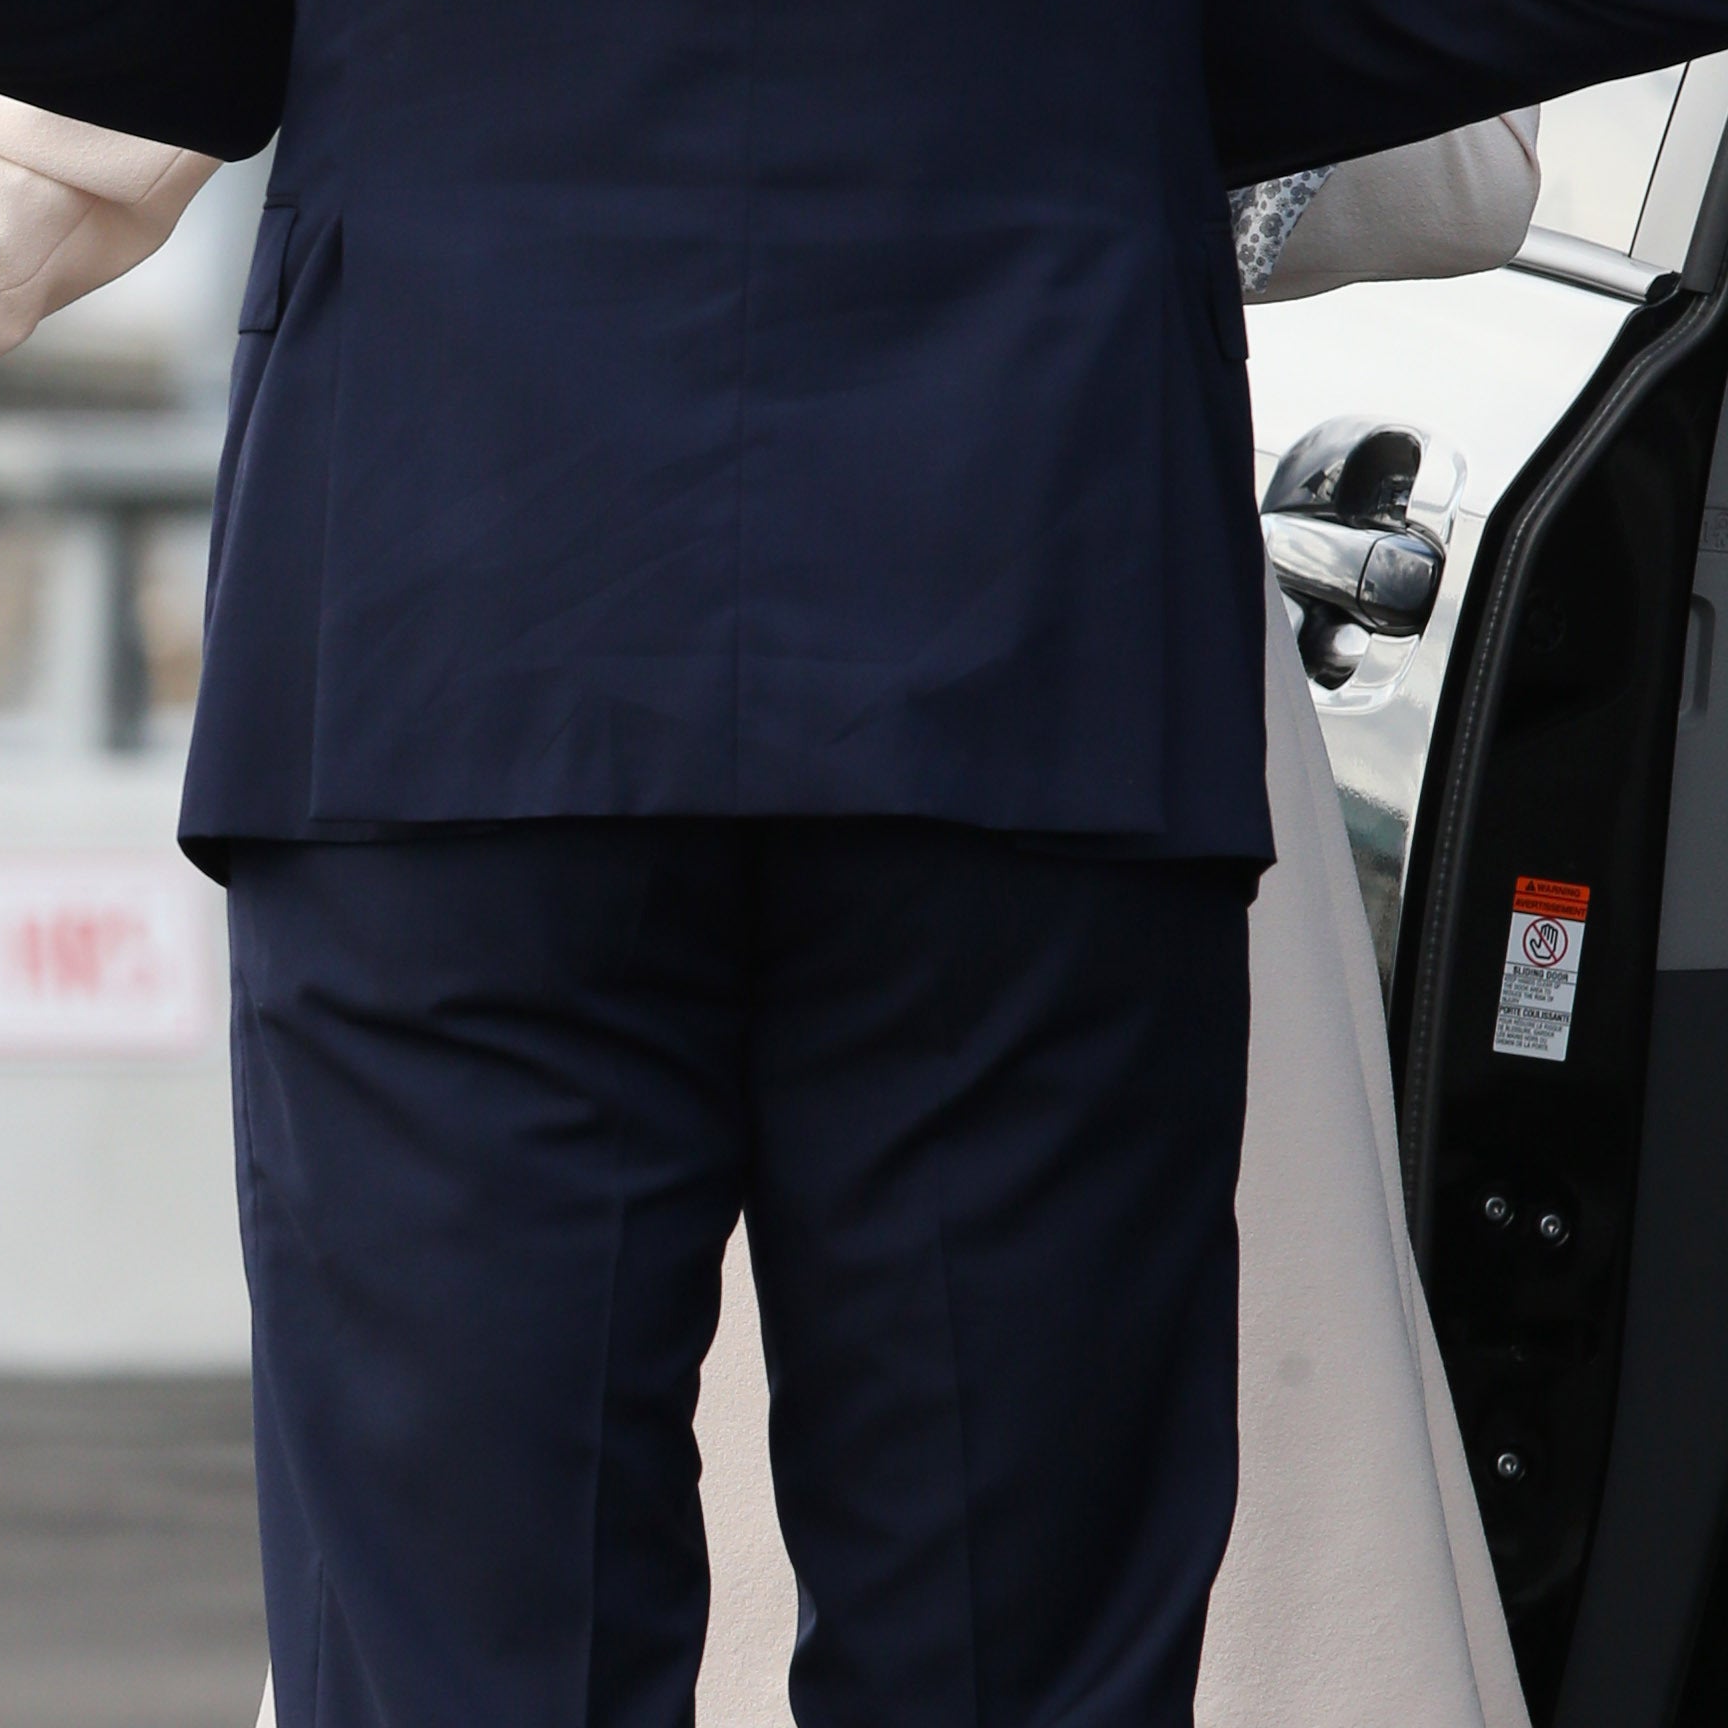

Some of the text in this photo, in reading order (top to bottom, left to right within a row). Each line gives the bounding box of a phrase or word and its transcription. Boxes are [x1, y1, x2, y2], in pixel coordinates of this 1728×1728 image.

[1537, 883, 1581, 897] WARNING
[1515, 898, 1586, 917] AVERTISSEMENT
[1513, 966, 1569, 982] SLIDING DOOR
[1500, 1005, 1521, 1016] PORTE
